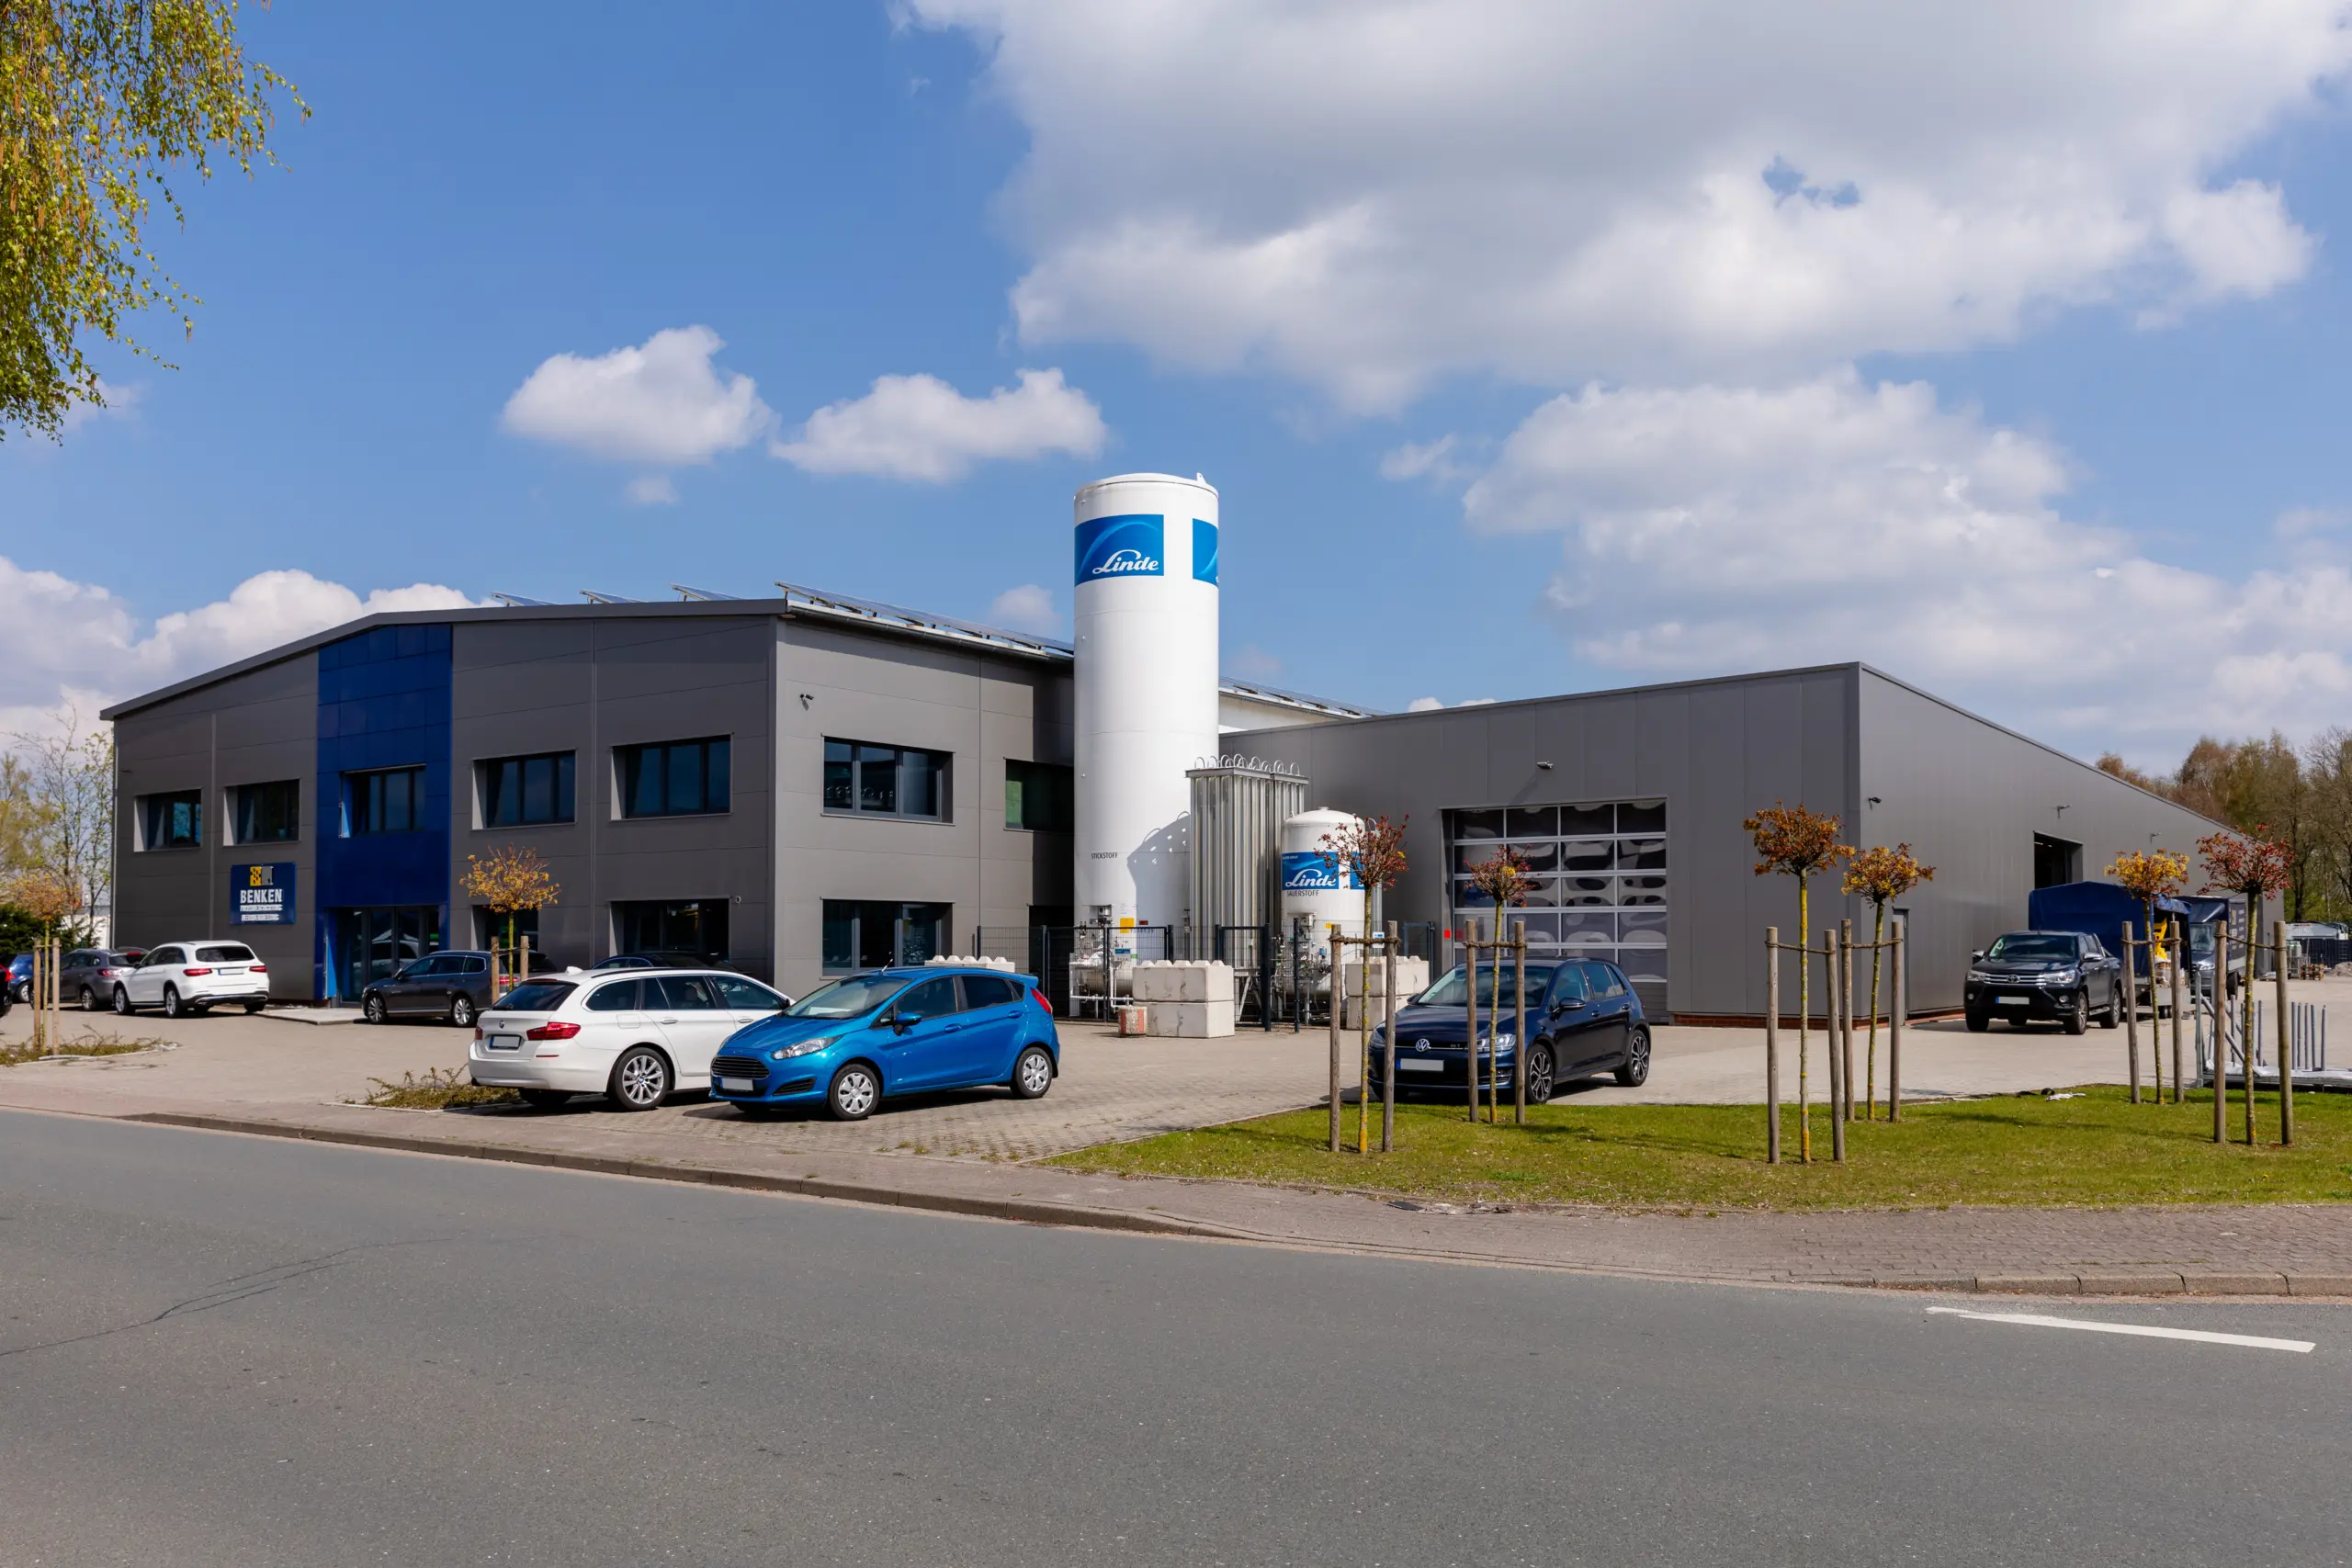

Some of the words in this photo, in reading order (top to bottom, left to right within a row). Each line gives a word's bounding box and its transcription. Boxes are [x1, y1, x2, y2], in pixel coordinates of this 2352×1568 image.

[1091, 549, 1159, 574] Linde
[1284, 868, 1337, 888] Linde
[240, 888, 283, 904] BENKEN
[1286, 889, 1319, 897] SAUERSTOFF
